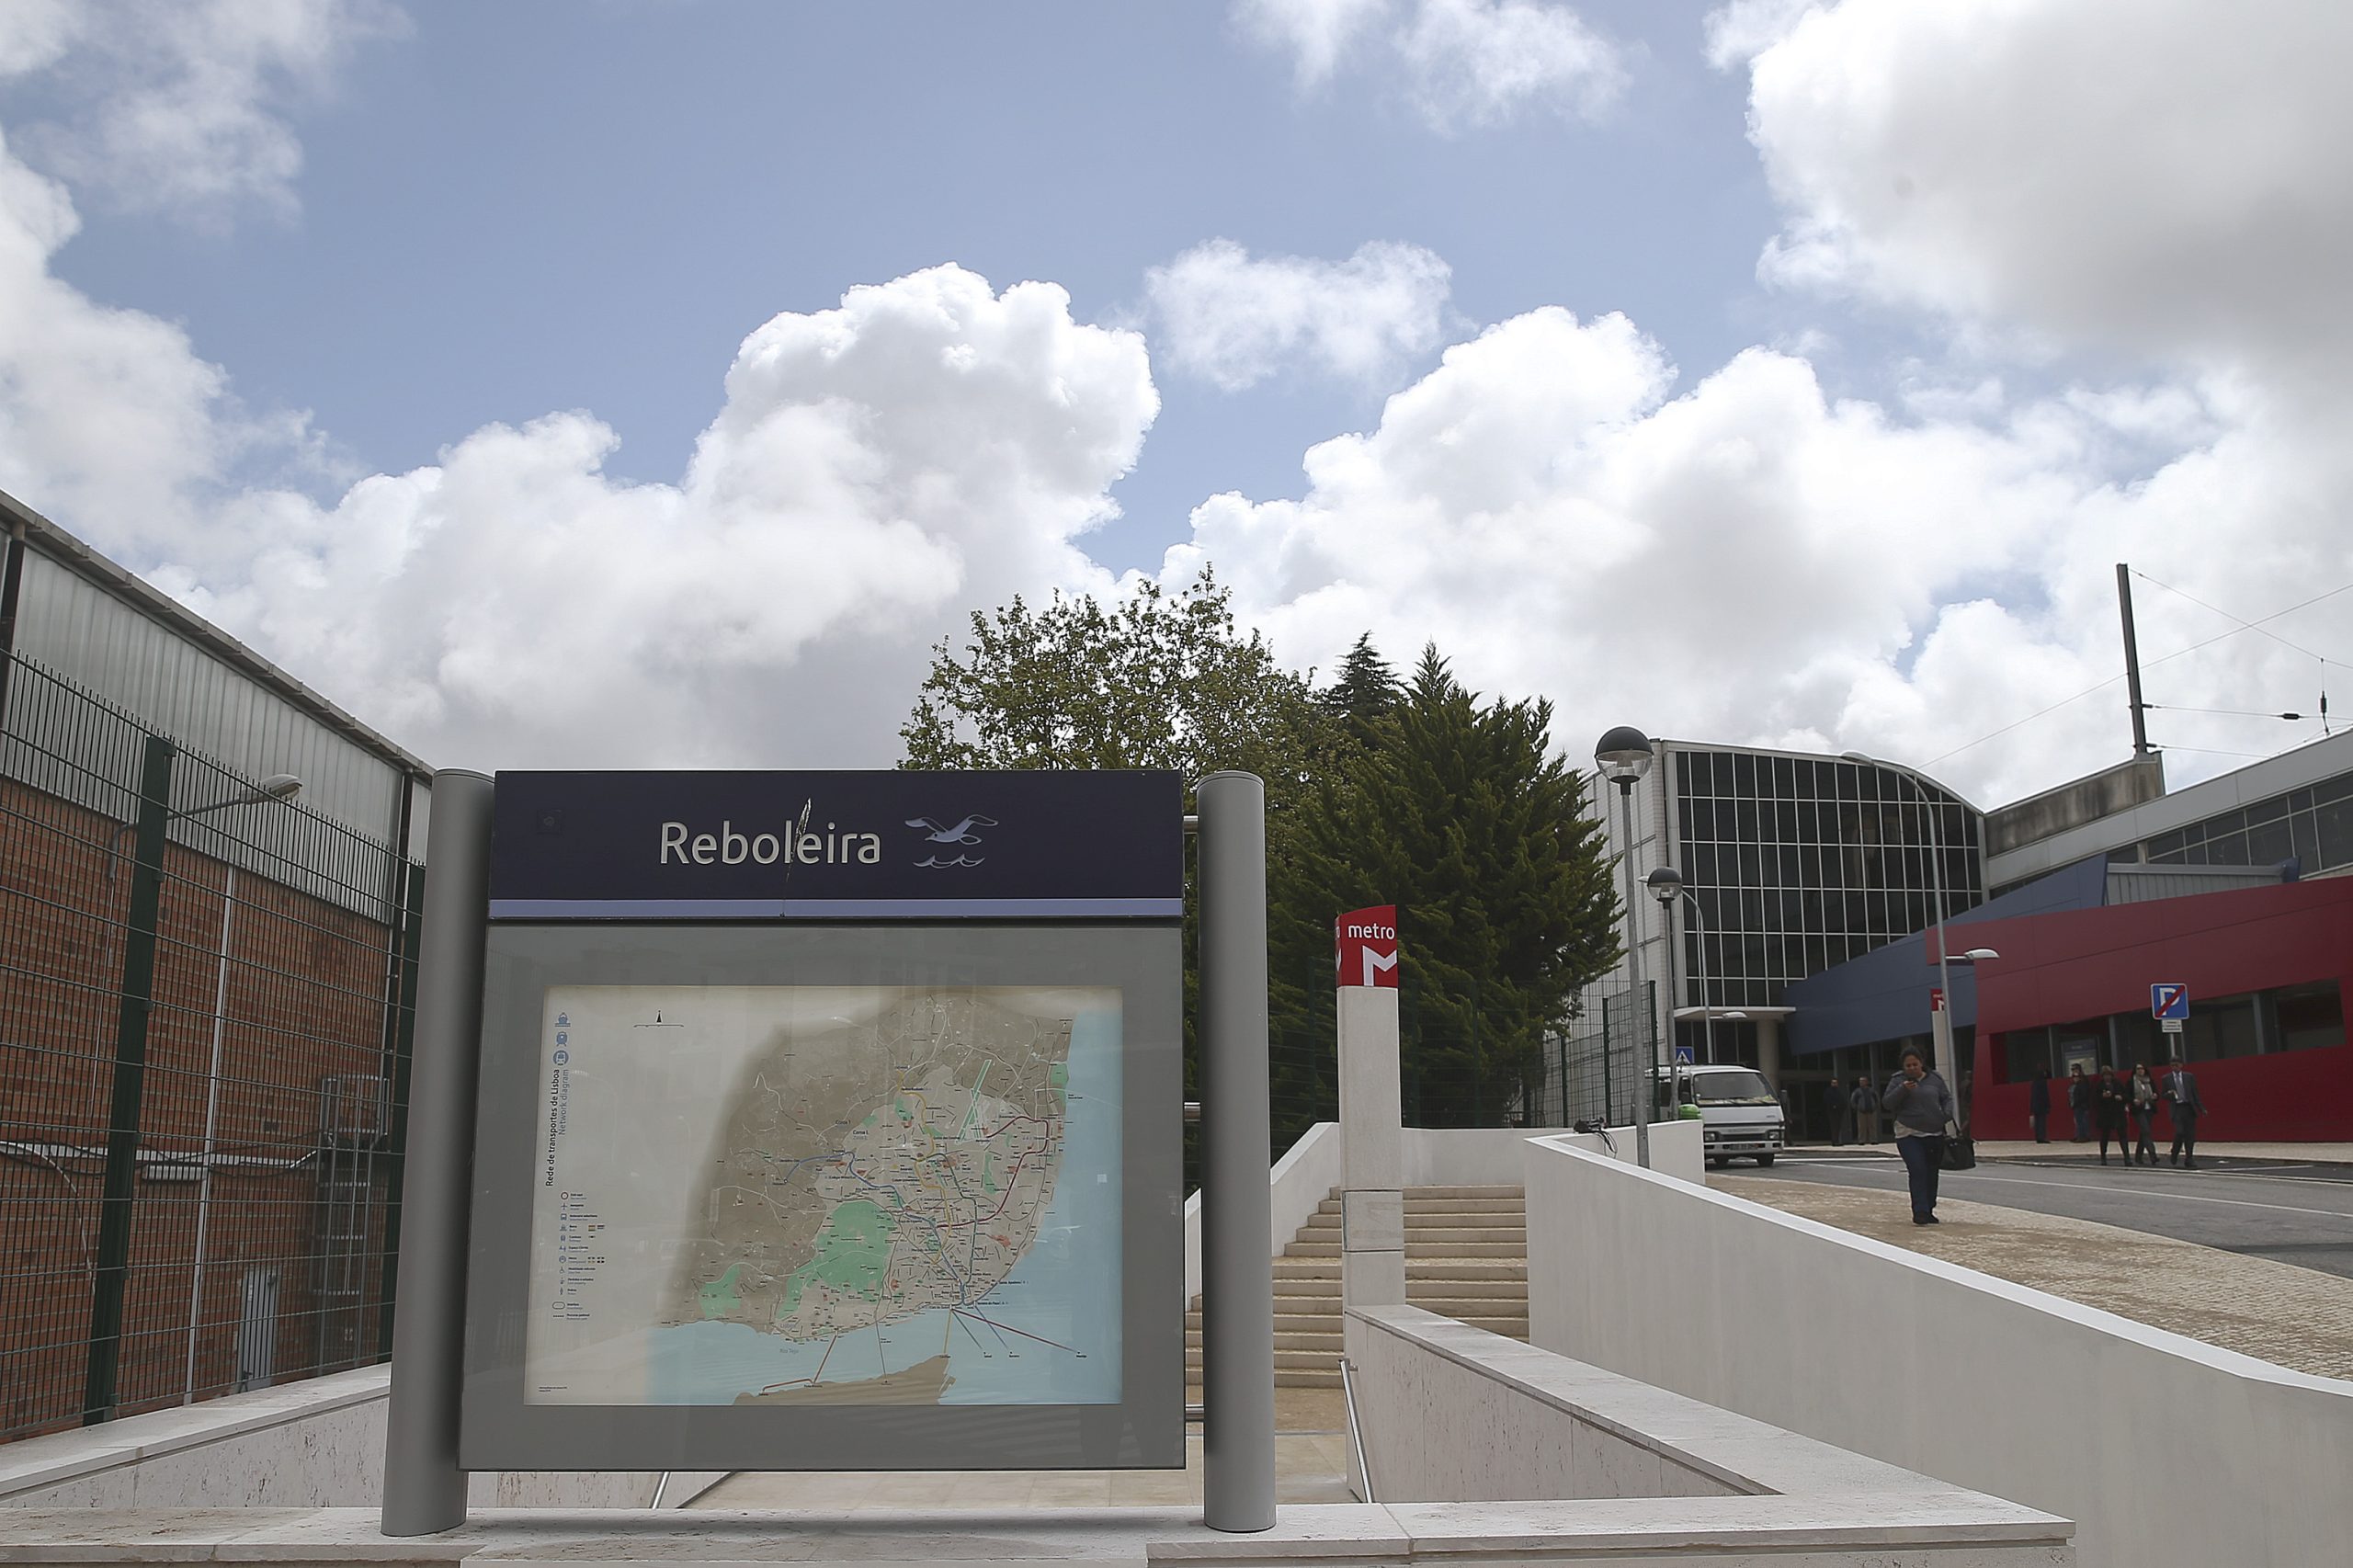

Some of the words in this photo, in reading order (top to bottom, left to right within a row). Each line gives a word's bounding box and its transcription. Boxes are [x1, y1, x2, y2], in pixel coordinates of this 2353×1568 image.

[660, 818, 881, 865] Reboleira
[1348, 923, 1395, 939] metro
[2159, 987, 2180, 1016] P
[551, 1069, 560, 1095] Lisboa
[560, 1069, 570, 1100] diagram
[550, 1096, 558, 1106] de
[548, 1108, 558, 1153] transportes
[558, 1102, 567, 1135] Network
[547, 1154, 555, 1165] de
[545, 1166, 554, 1187] Rede
